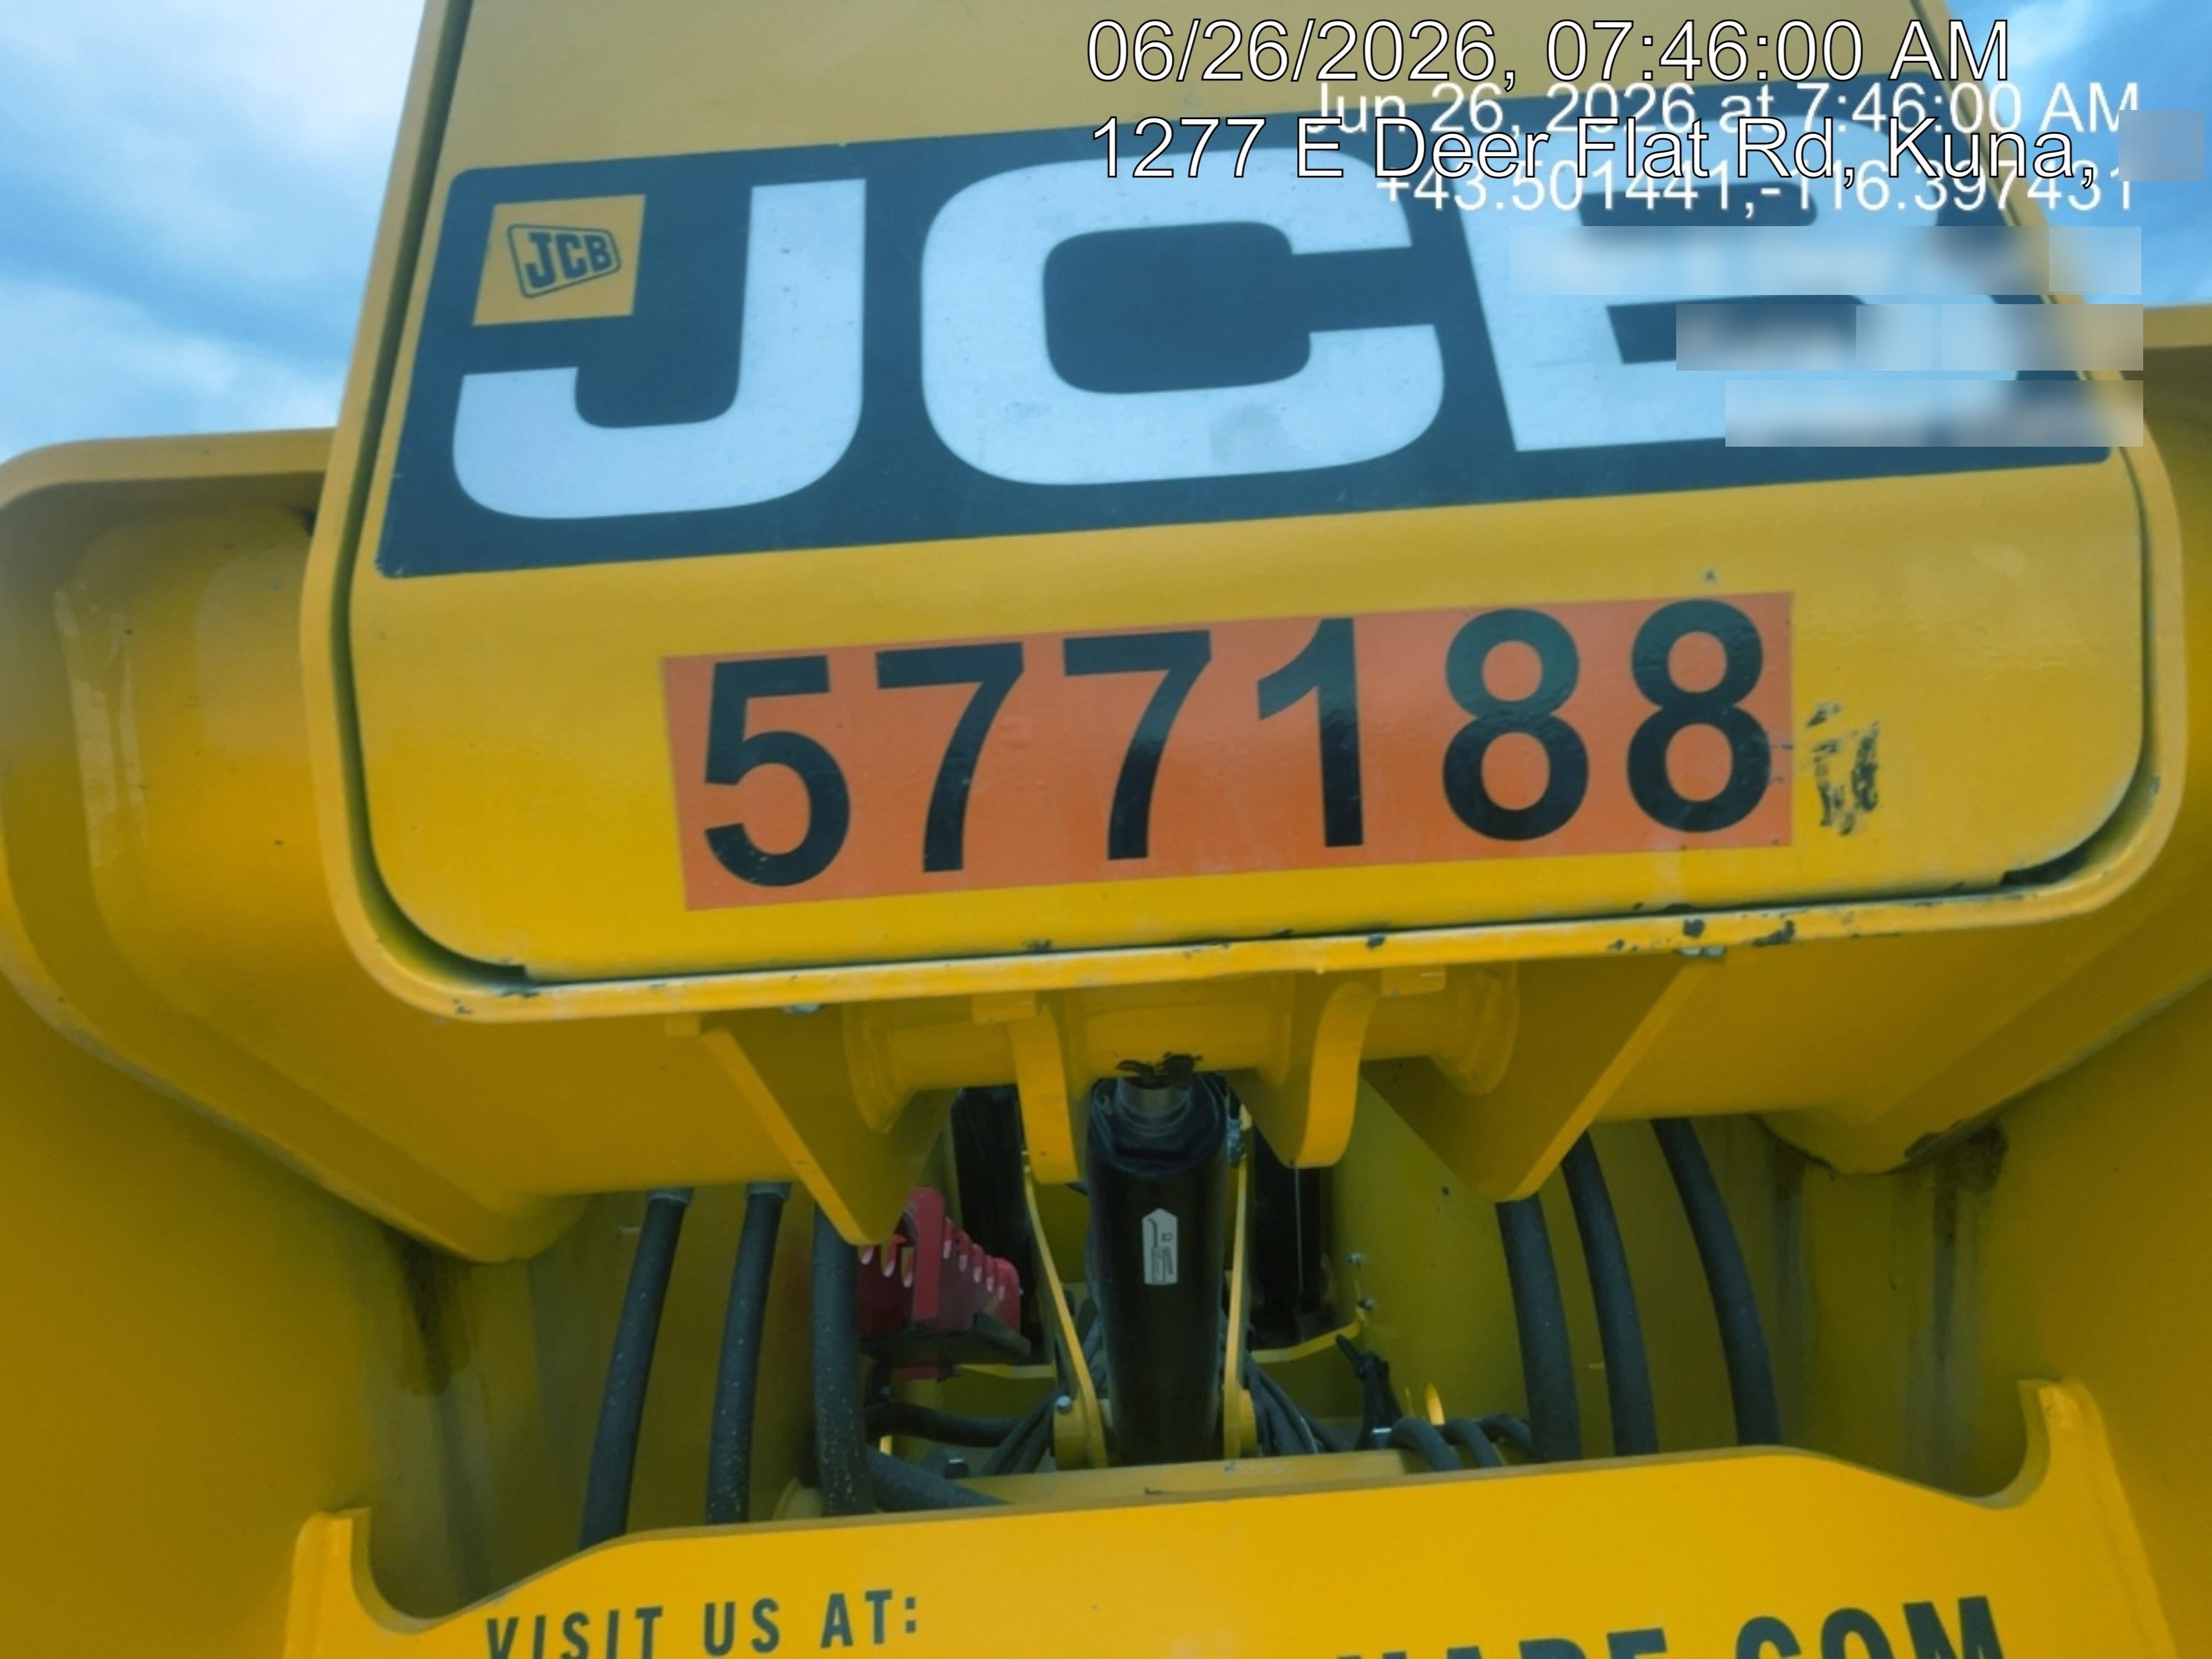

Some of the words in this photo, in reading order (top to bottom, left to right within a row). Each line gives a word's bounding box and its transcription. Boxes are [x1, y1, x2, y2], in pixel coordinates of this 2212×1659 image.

[525, 231, 613, 288] JCB
[702, 598, 1772, 886] 577188
[486, 1606, 663, 1659] VISIT
[703, 1598, 780, 1657] US
[820, 1589, 917, 1649] AT:
